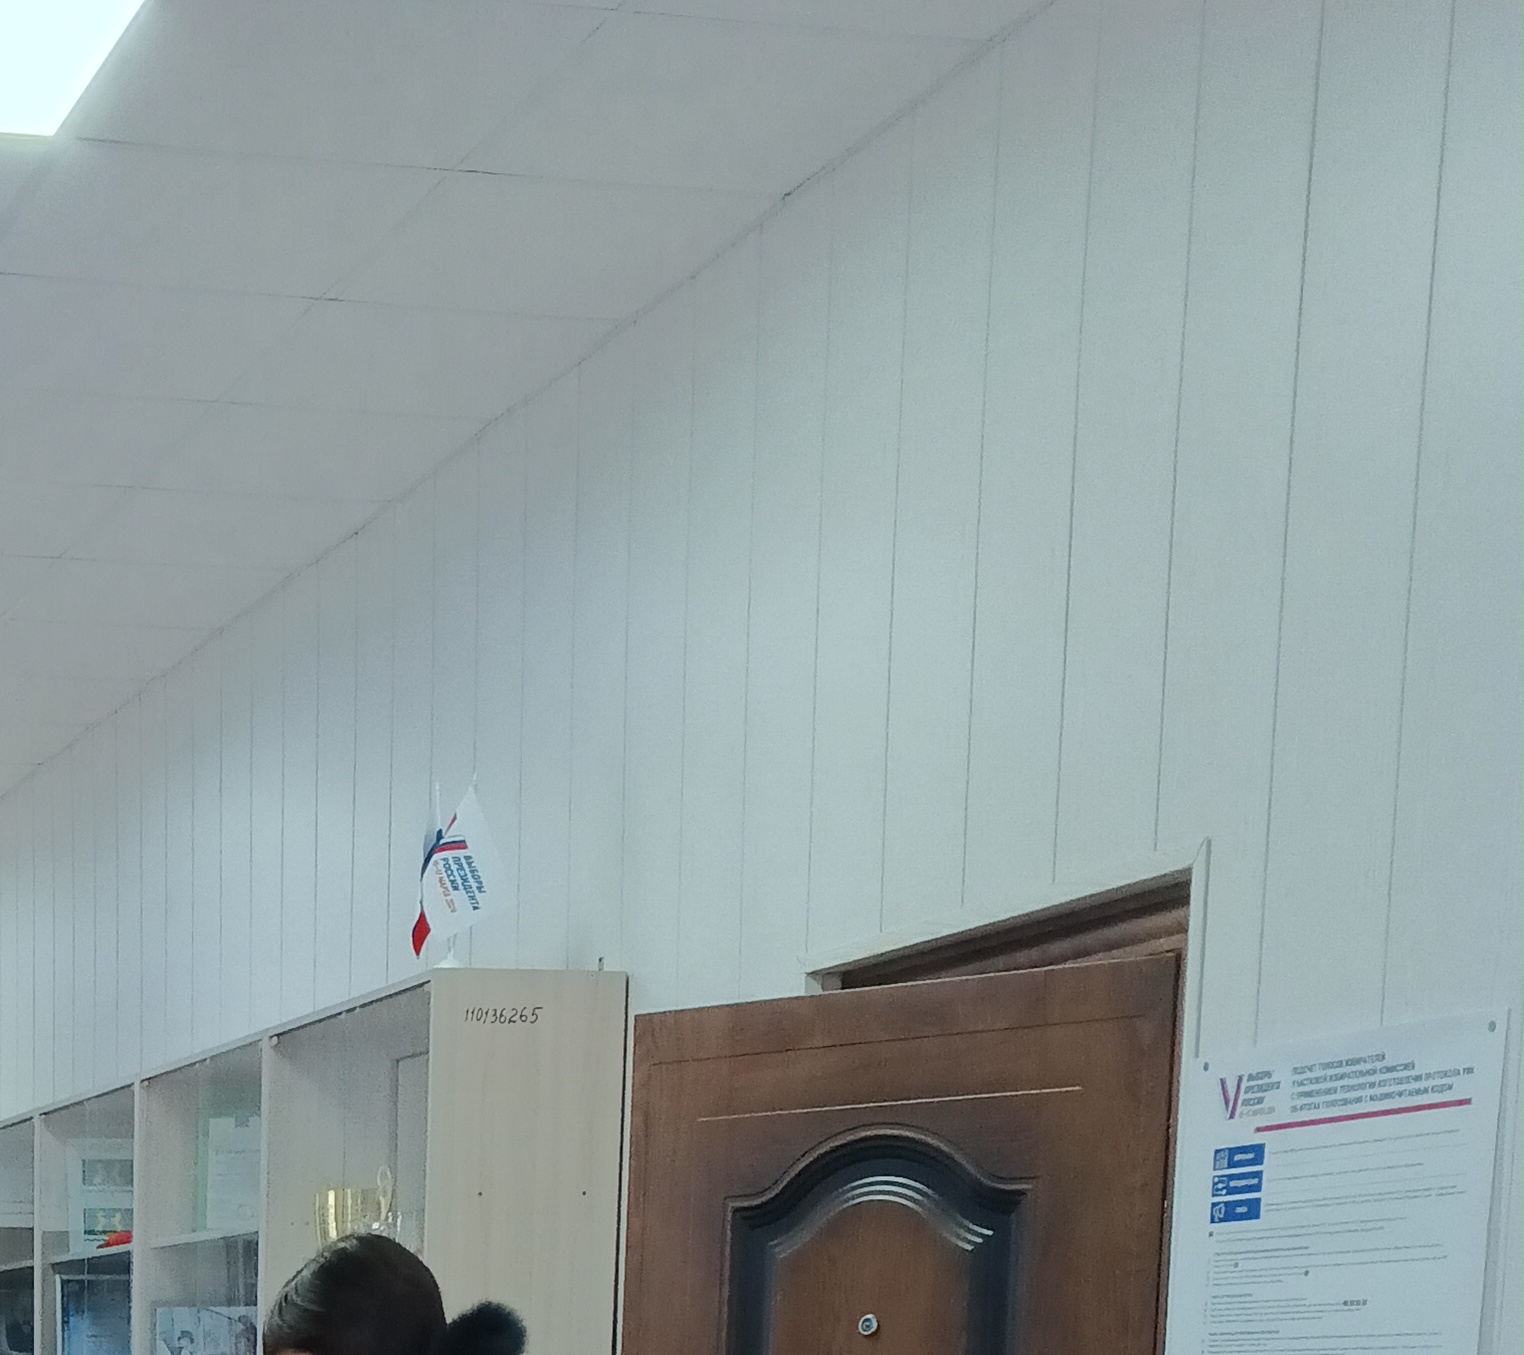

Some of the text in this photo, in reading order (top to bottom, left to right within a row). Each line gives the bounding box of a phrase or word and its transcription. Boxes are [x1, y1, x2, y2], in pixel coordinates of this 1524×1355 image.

[451, 856, 481, 911] ПРЕЗИДЕНТА
[463, 855, 487, 894] ВЫБОРЫ
[464, 1006, 544, 1025] 110136265
